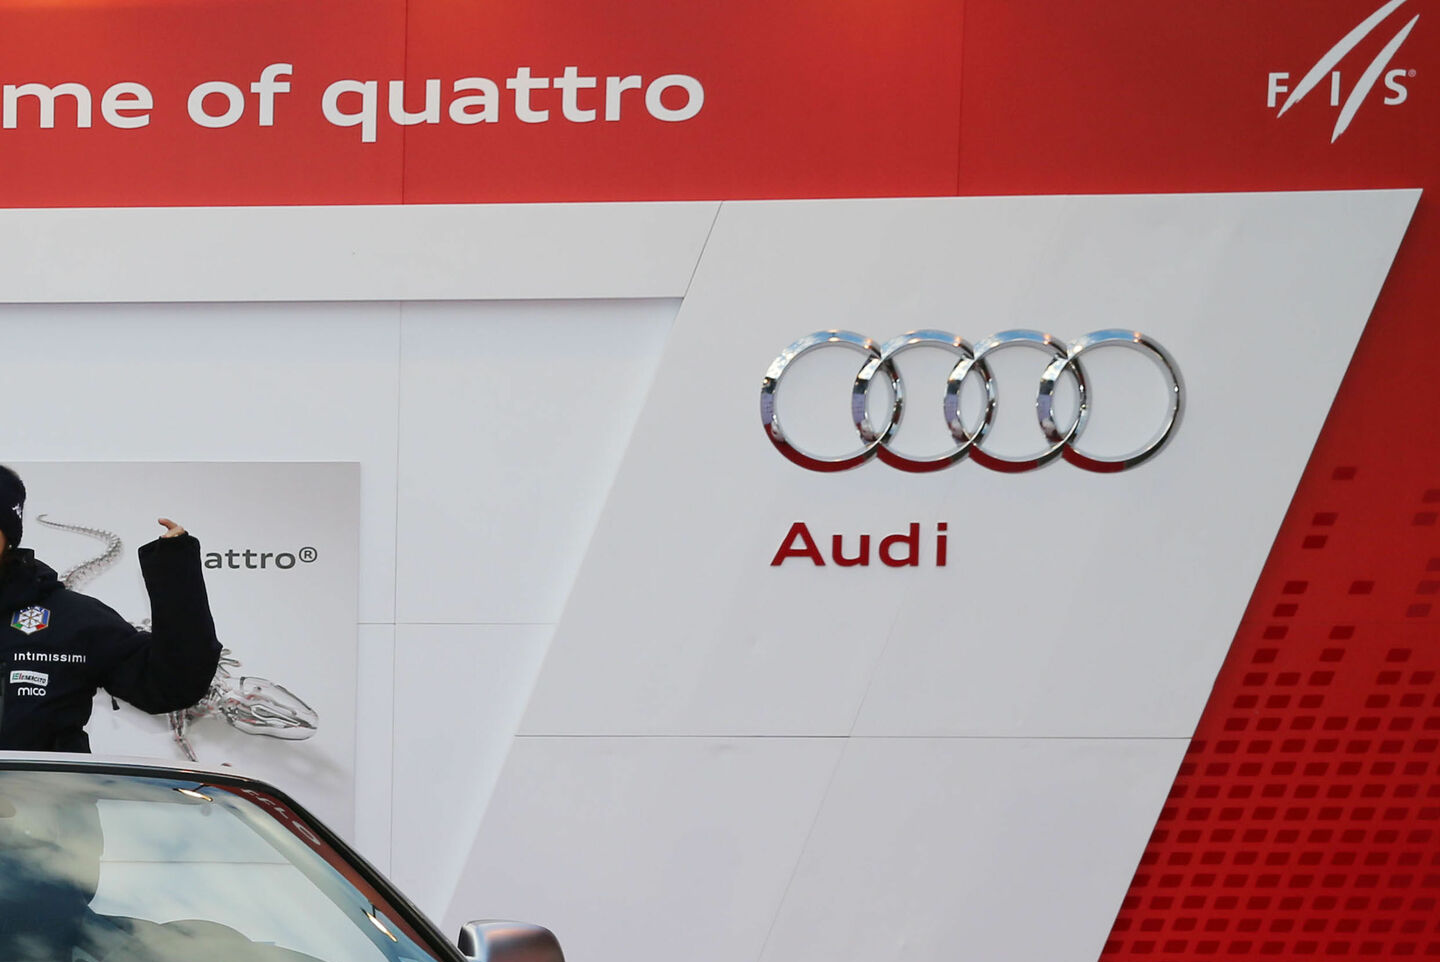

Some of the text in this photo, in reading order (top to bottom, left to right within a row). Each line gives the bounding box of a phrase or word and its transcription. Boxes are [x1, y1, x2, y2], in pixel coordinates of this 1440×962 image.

[186, 63, 293, 128] of
[320, 65, 706, 143] quattro
[770, 522, 949, 568] Audi
[204, 546, 318, 570] attro®
[14, 652, 87, 663] intimissimi
[17, 686, 47, 697] mico
